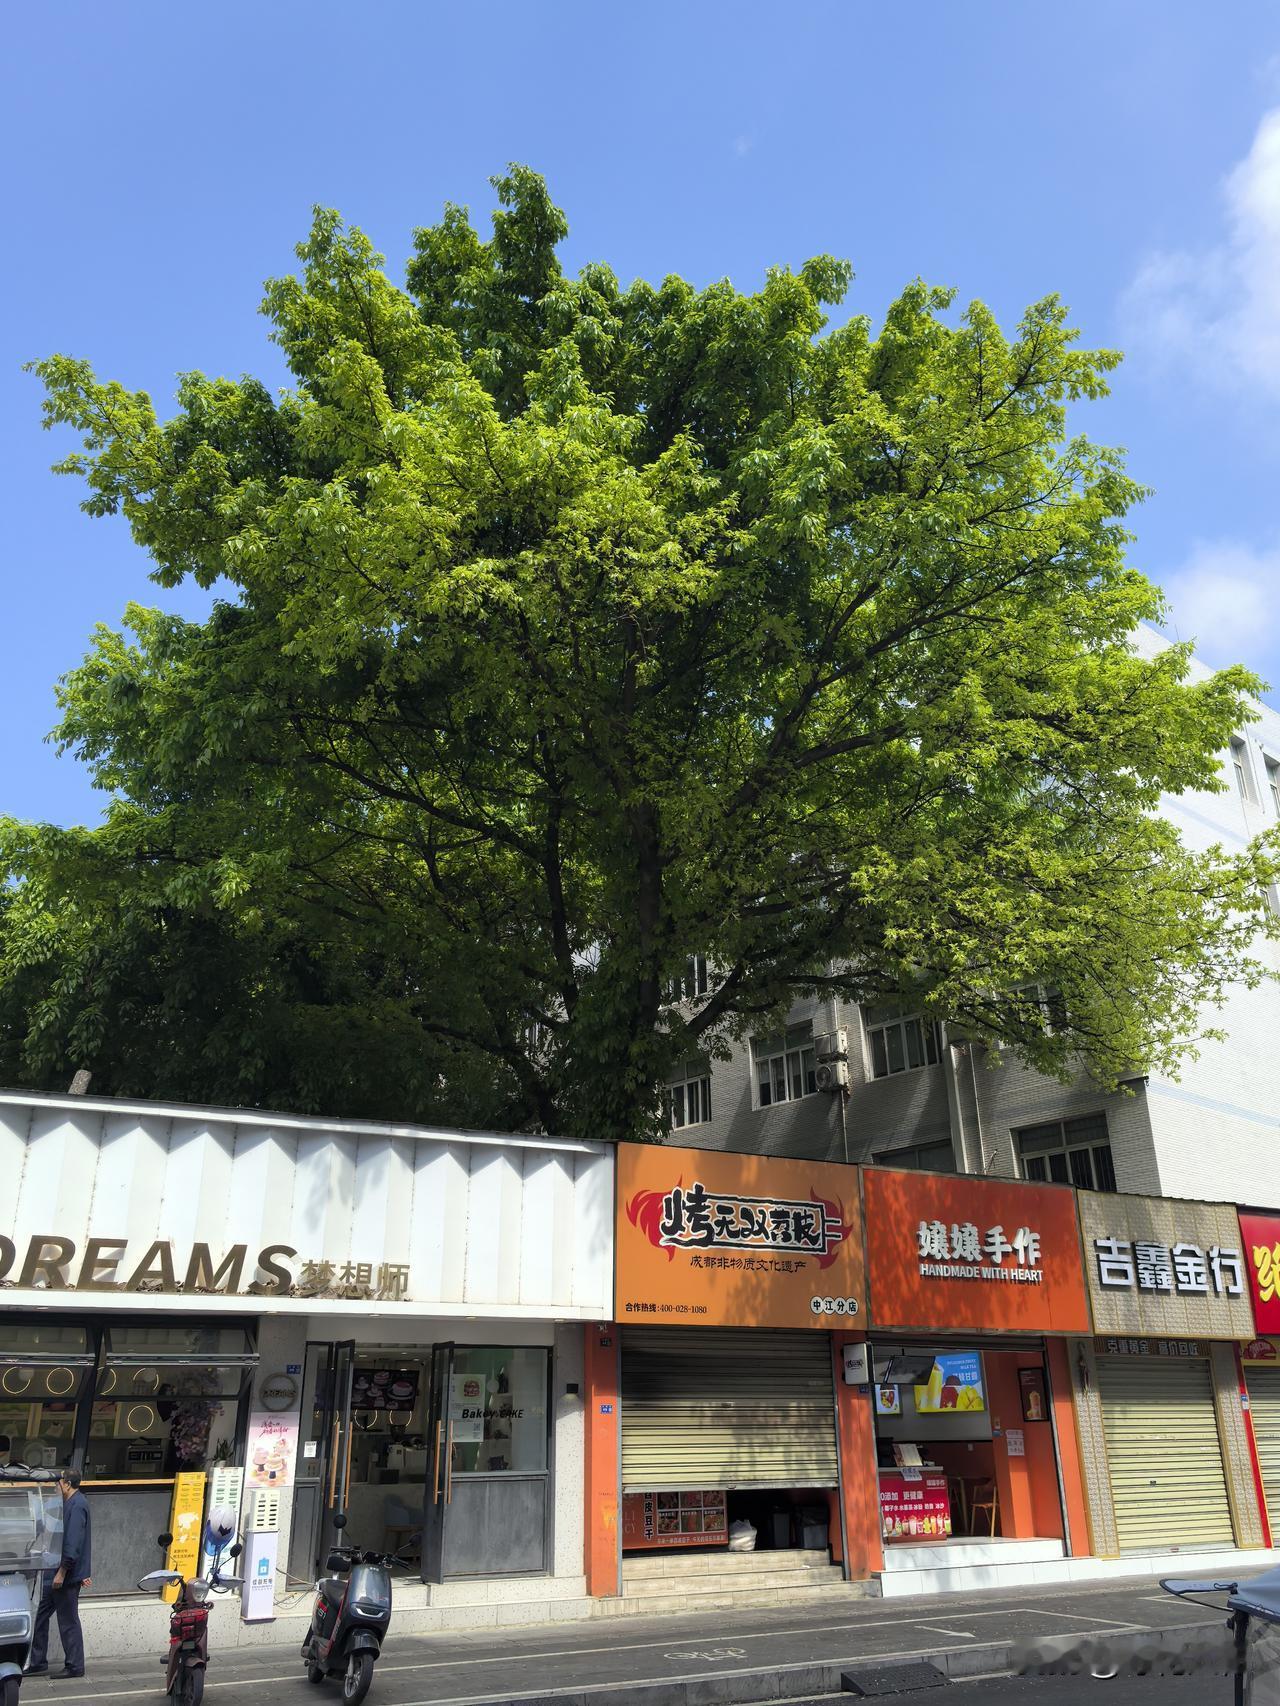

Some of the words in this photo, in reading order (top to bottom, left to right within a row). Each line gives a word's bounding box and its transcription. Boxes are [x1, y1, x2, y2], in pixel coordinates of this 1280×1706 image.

[690, 1255, 806, 1273] 成都非物质文化遗产
[920, 1263, 980, 1278] HANDMADE
[981, 1266, 1008, 1280] WITH
[1010, 1269, 1043, 1281] HEART
[1094, 1237, 1244, 1294] 吉鑫金行
[301, 1259, 411, 1301] 梦想师
[812, 1297, 858, 1315] 中江分店
